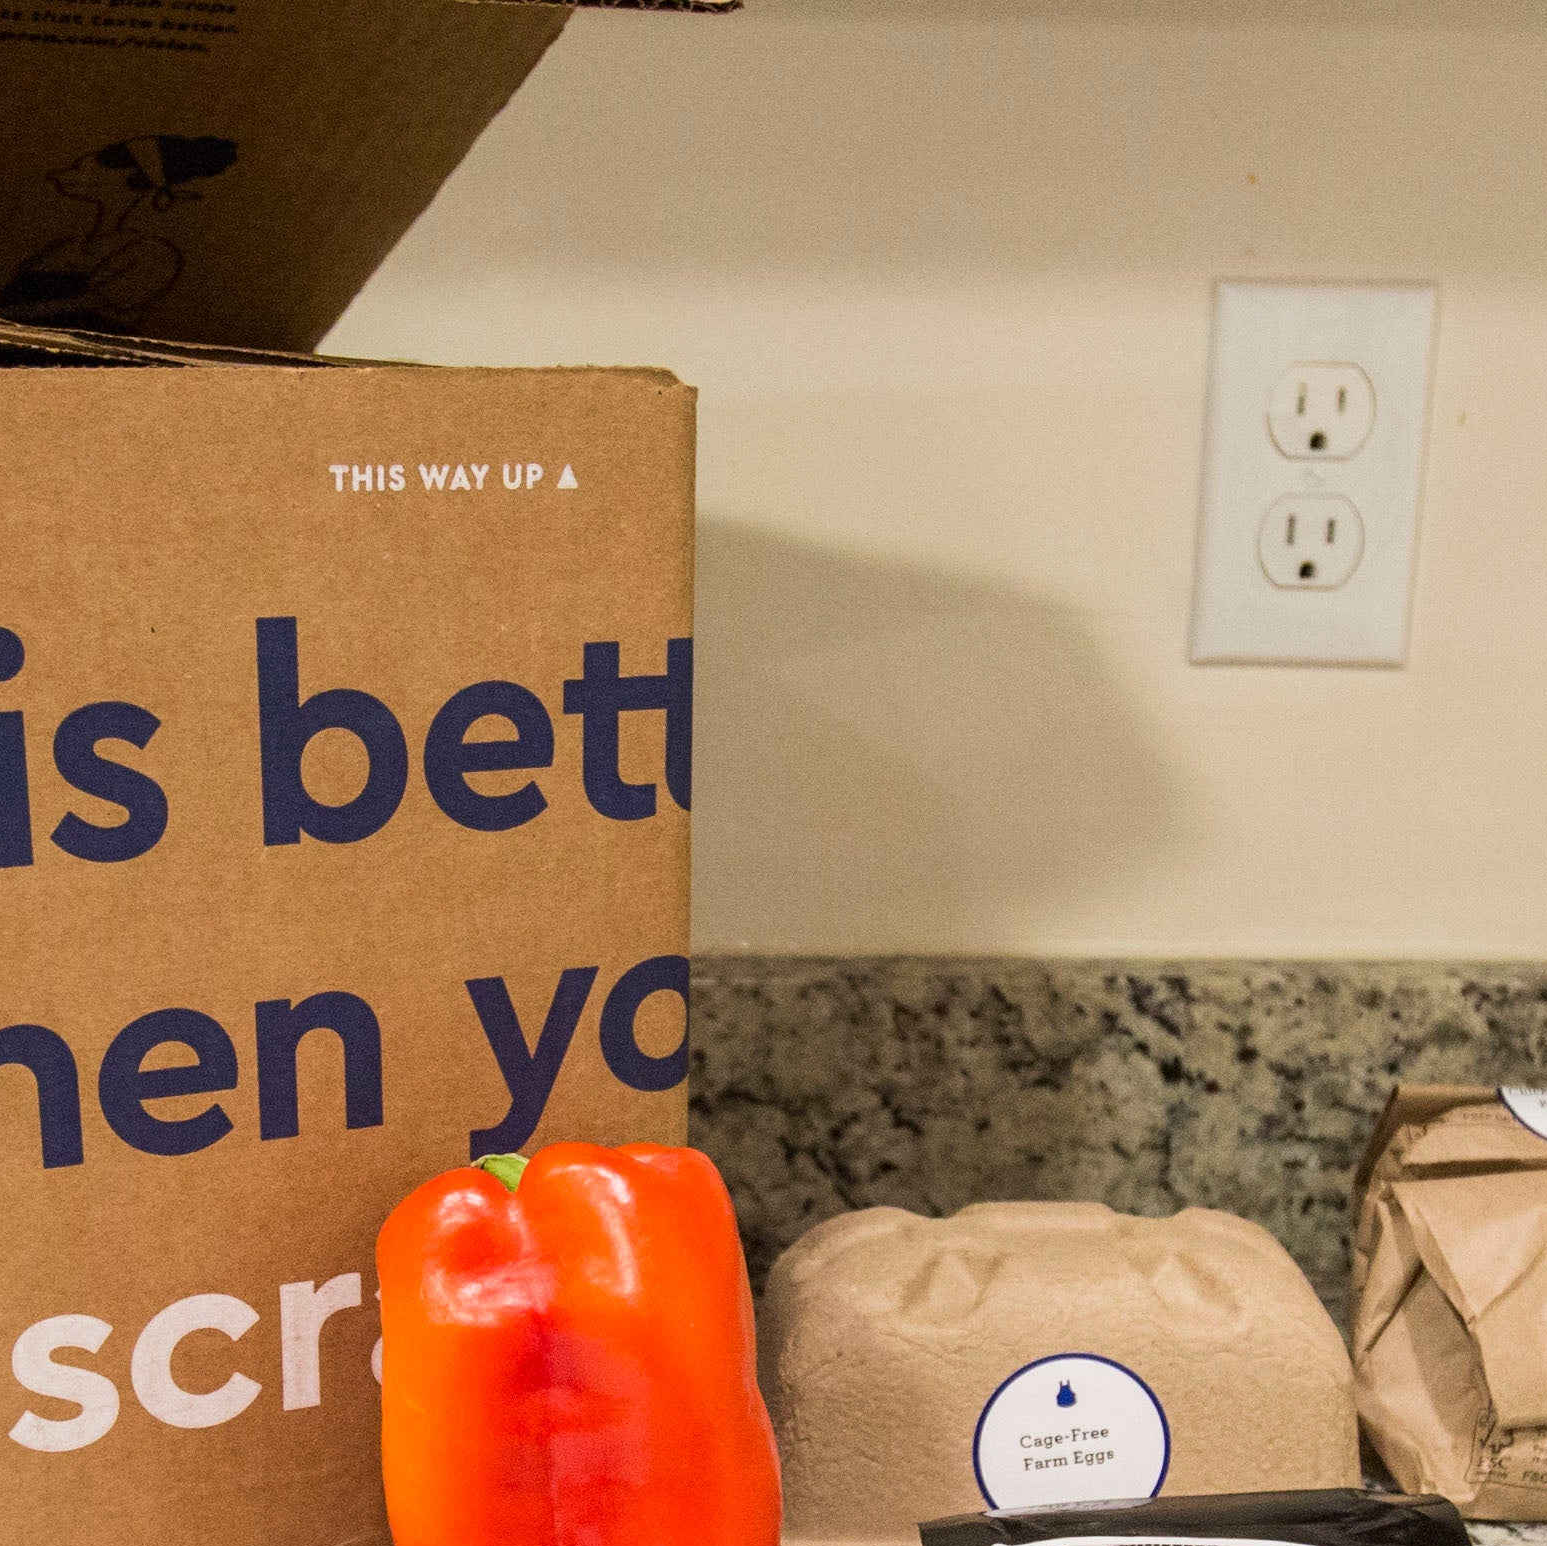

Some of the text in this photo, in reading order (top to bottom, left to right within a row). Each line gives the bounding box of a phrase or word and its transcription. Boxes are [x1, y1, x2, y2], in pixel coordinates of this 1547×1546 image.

[329, 463, 544, 491] THIS WAY UP
[255, 616, 694, 848] bett
[464, 953, 693, 1155] yo
[9, 1268, 384, 1454] scr
[1020, 1428, 1110, 1449] Cage-Free
[1024, 1450, 1115, 1471] Farm Eggs
